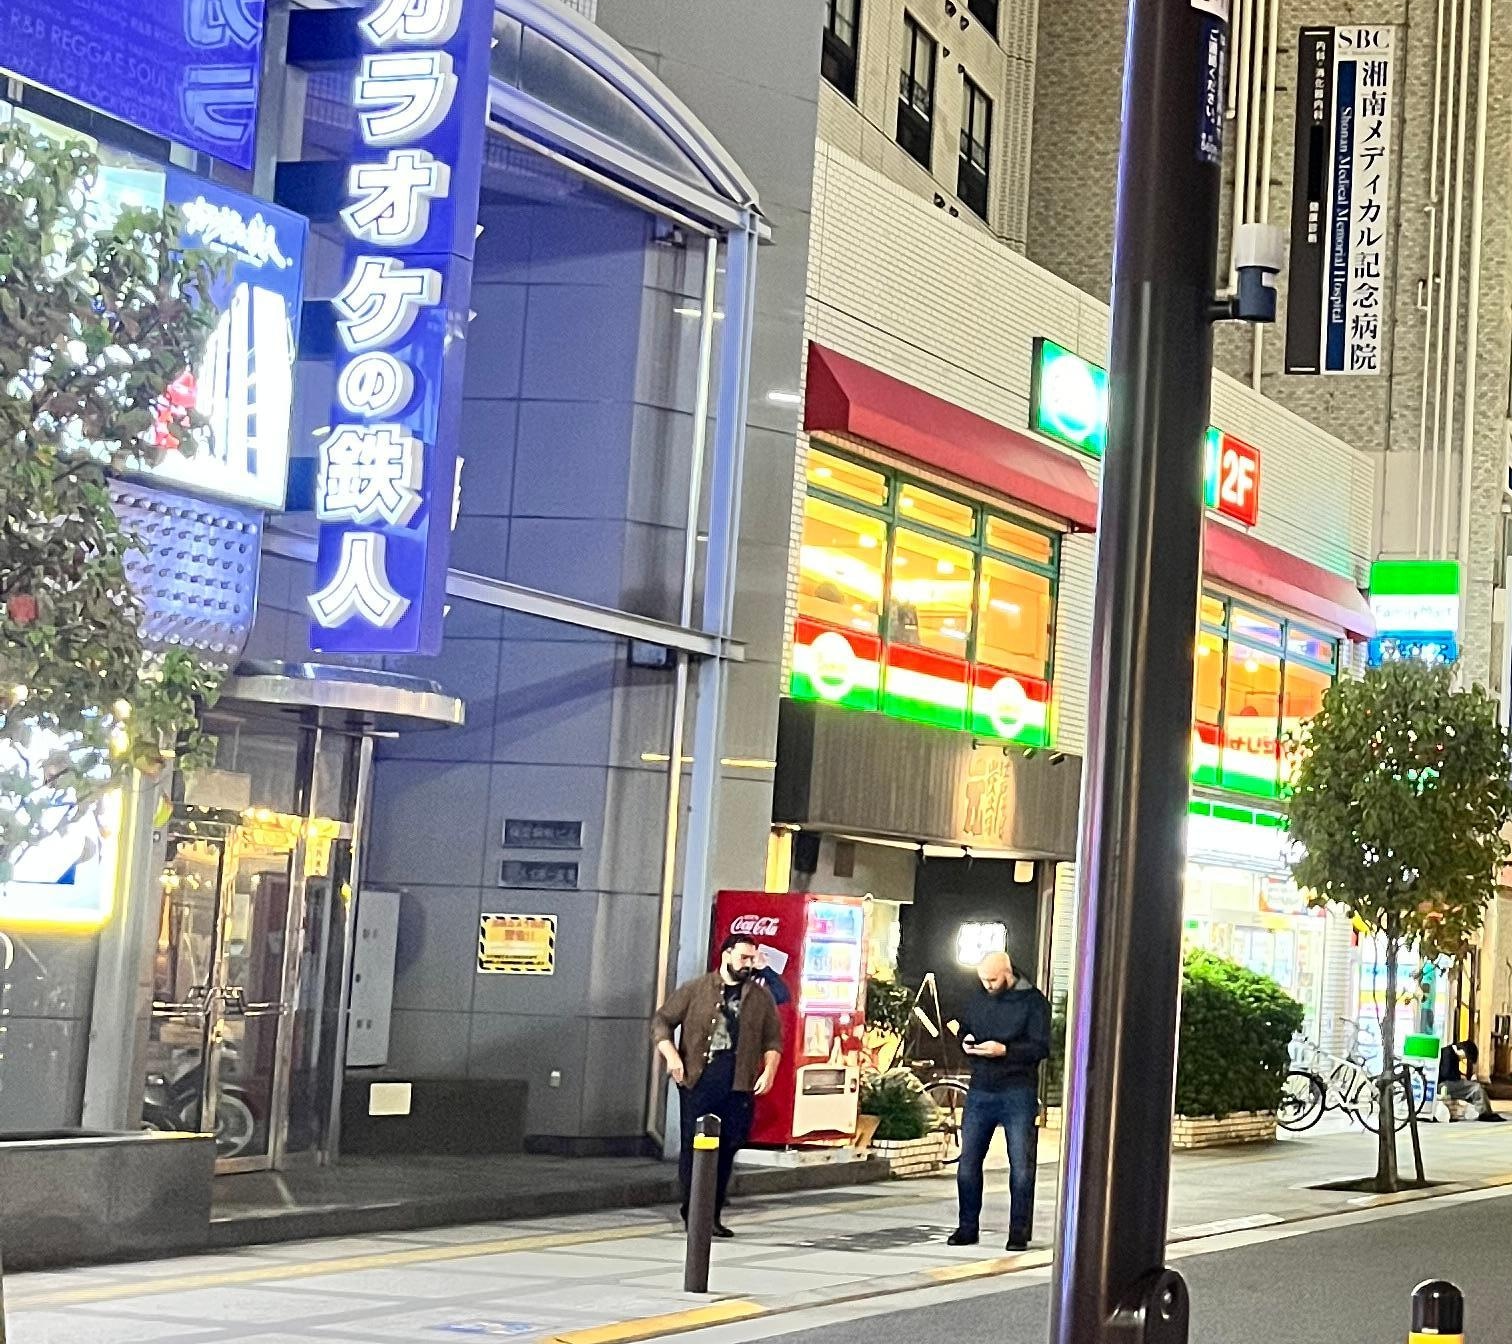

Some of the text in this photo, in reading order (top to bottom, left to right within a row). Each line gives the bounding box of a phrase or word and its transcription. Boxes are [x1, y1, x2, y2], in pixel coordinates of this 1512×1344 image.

[9, 3, 169, 95] R&B REGGAE SOUL
[1339, 29, 1389, 49] SBC
[1330, 106, 1353, 323] Shonan Medical Memorial Hospital
[1350, 60, 1389, 371] 湘南メディカル記念病院
[1222, 449, 1255, 507] 2F
[1375, 603, 1453, 619] FamilyMart
